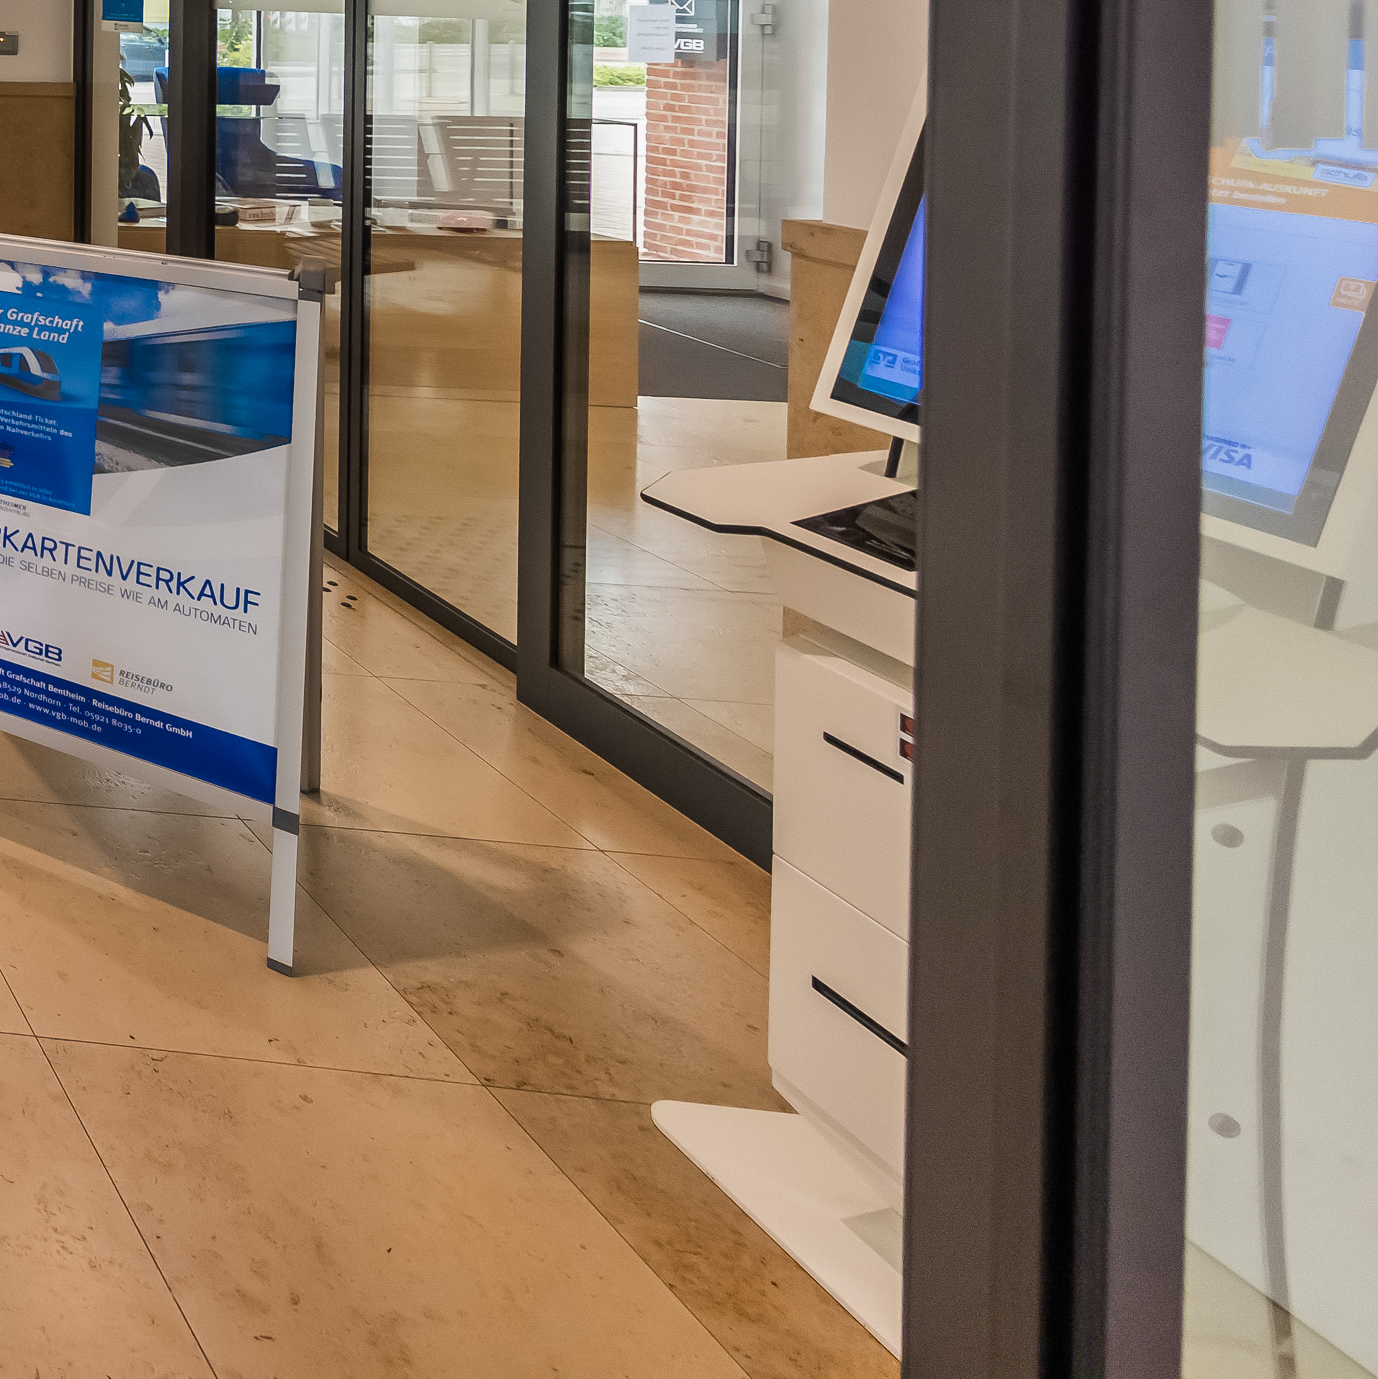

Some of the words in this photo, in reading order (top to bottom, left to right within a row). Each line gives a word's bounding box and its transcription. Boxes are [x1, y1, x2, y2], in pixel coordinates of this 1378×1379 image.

[1211, 177, 1330, 197] CHUFA-AUSKUNFT
[7, 308, 84, 333] Grafschaft
[32, 327, 69, 344] Land
[0, 415, 58, 434] Verkehrsmitteln
[59, 429, 73, 438] des
[6, 425, 52, 441] Nahverkehrs
[19, 559, 67, 583] SELBEN
[71, 574, 115, 596] PREISE
[119, 586, 144, 605] WIE
[147, 595, 169, 611] AM
[172, 602, 258, 636] AUTOMATEN
[5, 630, 63, 662] VGB
[118, 669, 174, 693] REISEBÜRO
[118, 678, 157, 696] BERNDT
[6, 670, 46, 690] Grafschaft
[48, 684, 86, 703] Bentheim
[92, 698, 134, 719] Reisebüro
[135, 712, 164, 730] Berndt
[165, 723, 193, 739] GmbH
[23, 687, 62, 708] Nordhorn
[69, 703, 82, 715] Tel.
[84, 710, 109, 724] 05921
[111, 717, 142, 735] 8035-0
[28, 701, 102, 733] www.vgb-mob.de
